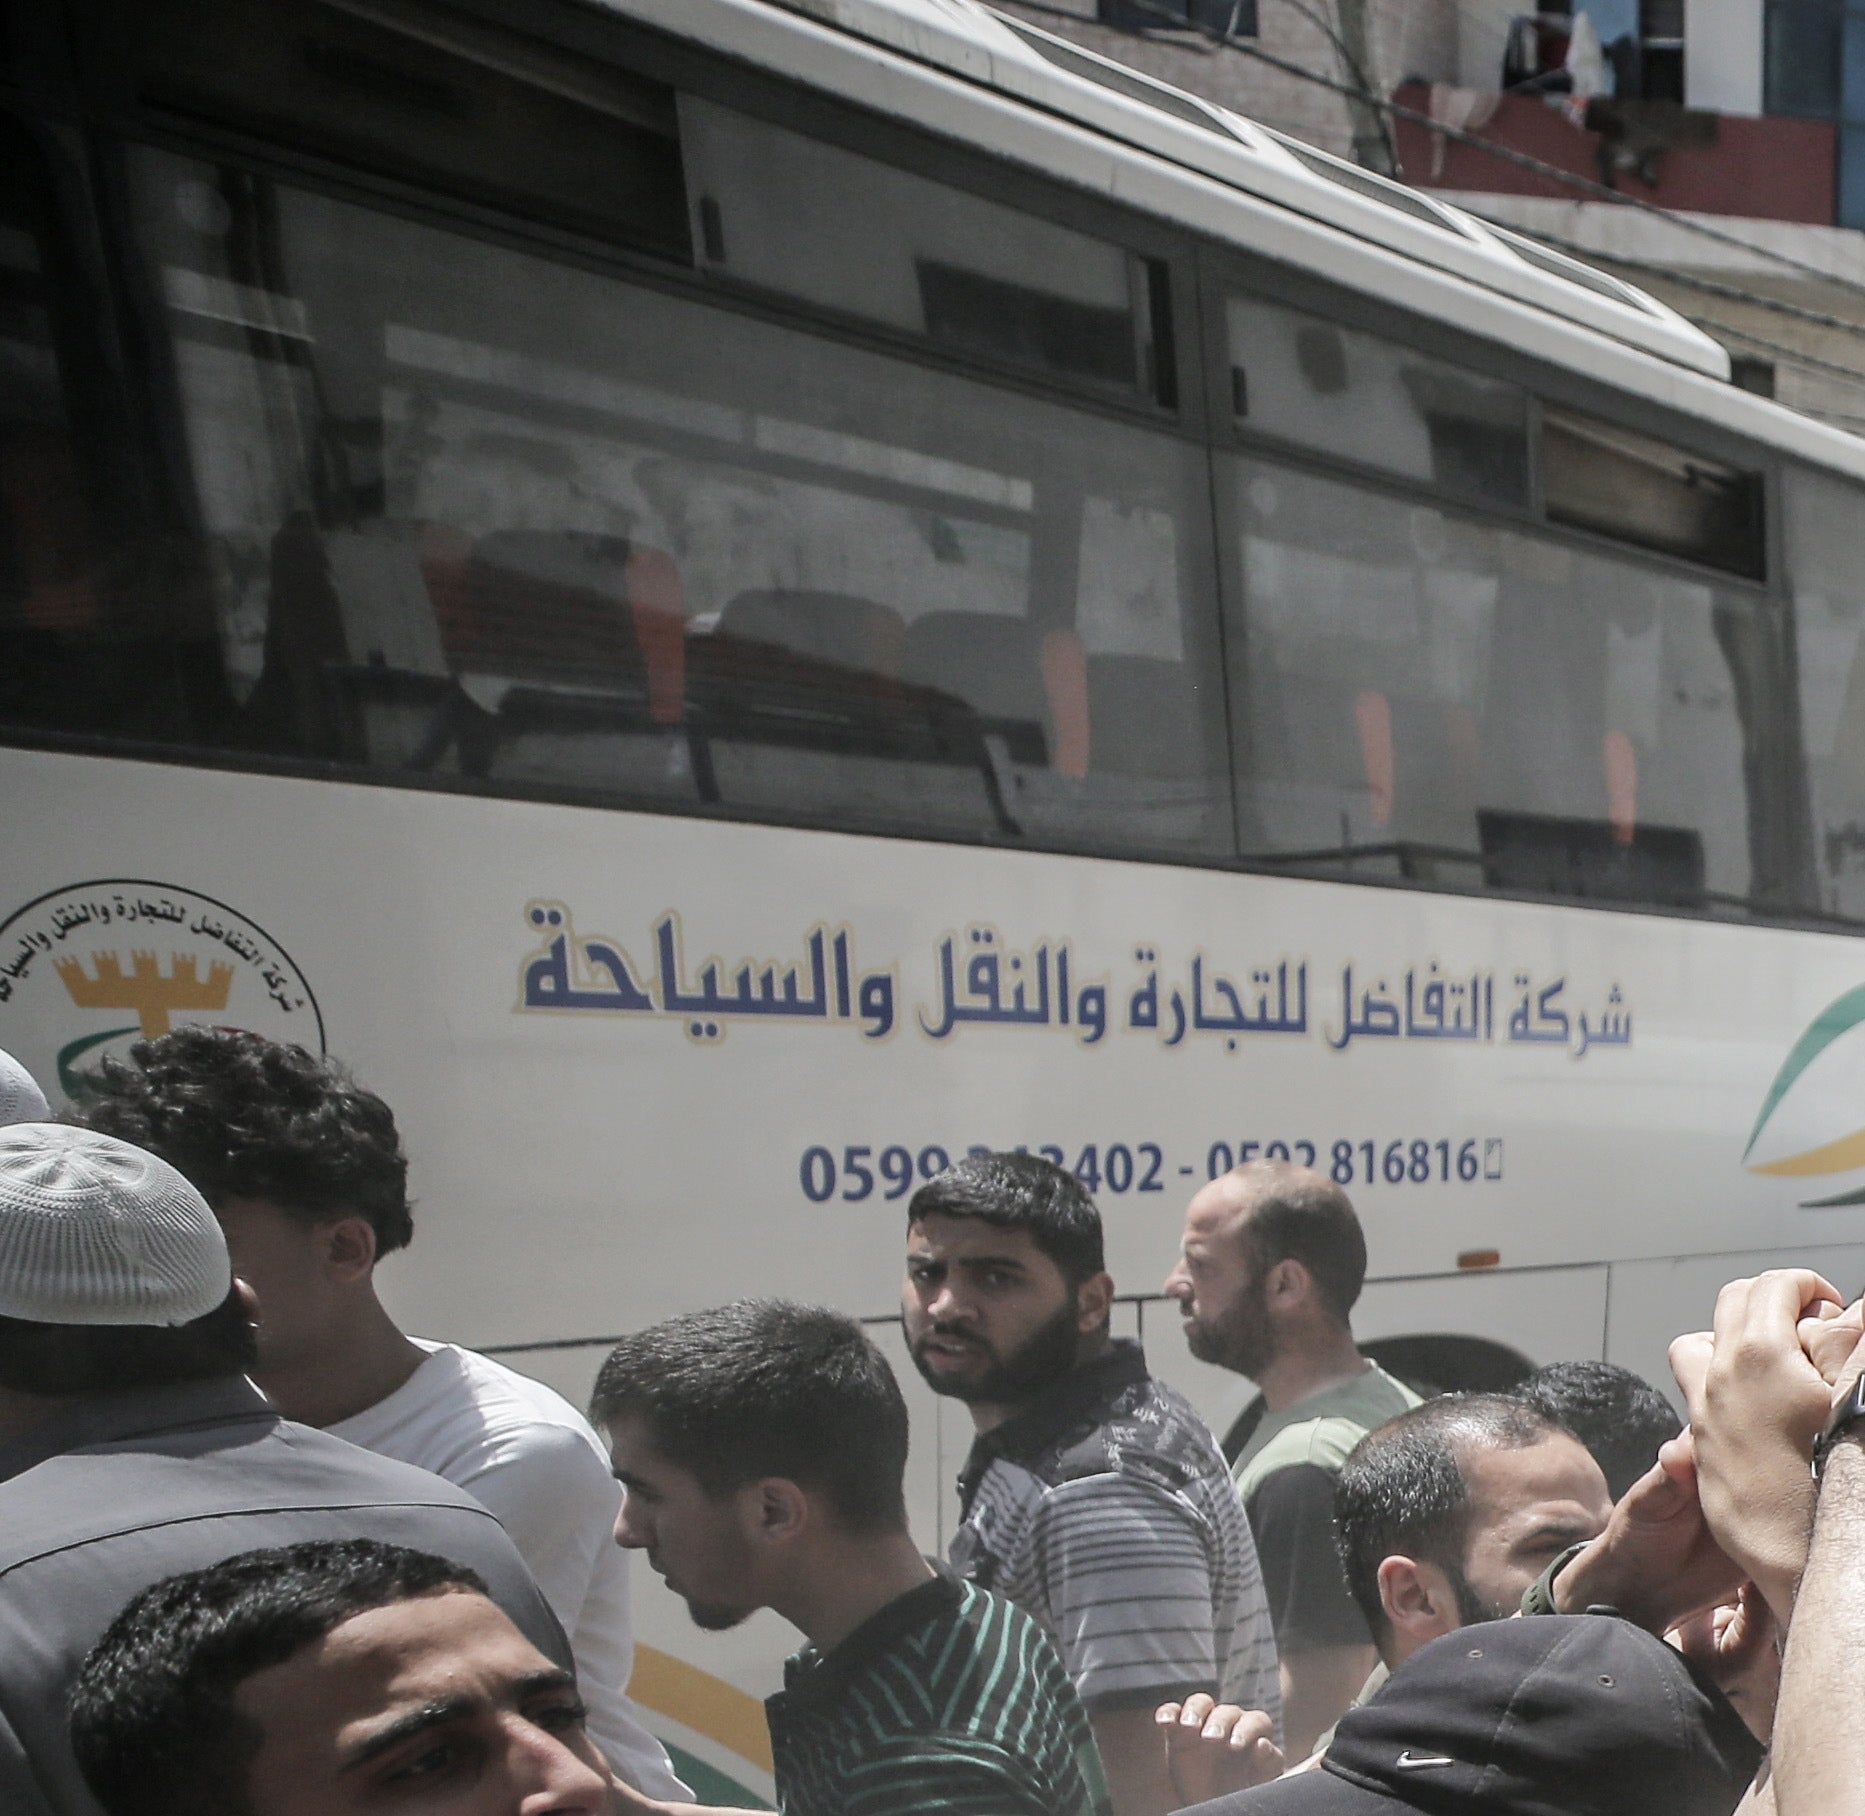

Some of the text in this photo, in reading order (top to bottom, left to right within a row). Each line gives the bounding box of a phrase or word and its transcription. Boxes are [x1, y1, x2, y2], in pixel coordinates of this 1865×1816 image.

[50, 902, 111, 940] والنقل
[113, 895, 186, 924] للتجارة
[190, 914, 264, 968] التفاضل
[262, 962, 304, 1011] شركة
[523, 905, 1632, 1057] شركة التفاضل للتجارة والنقل والسياحة
[1329, 1137, 1479, 1185] 816816
